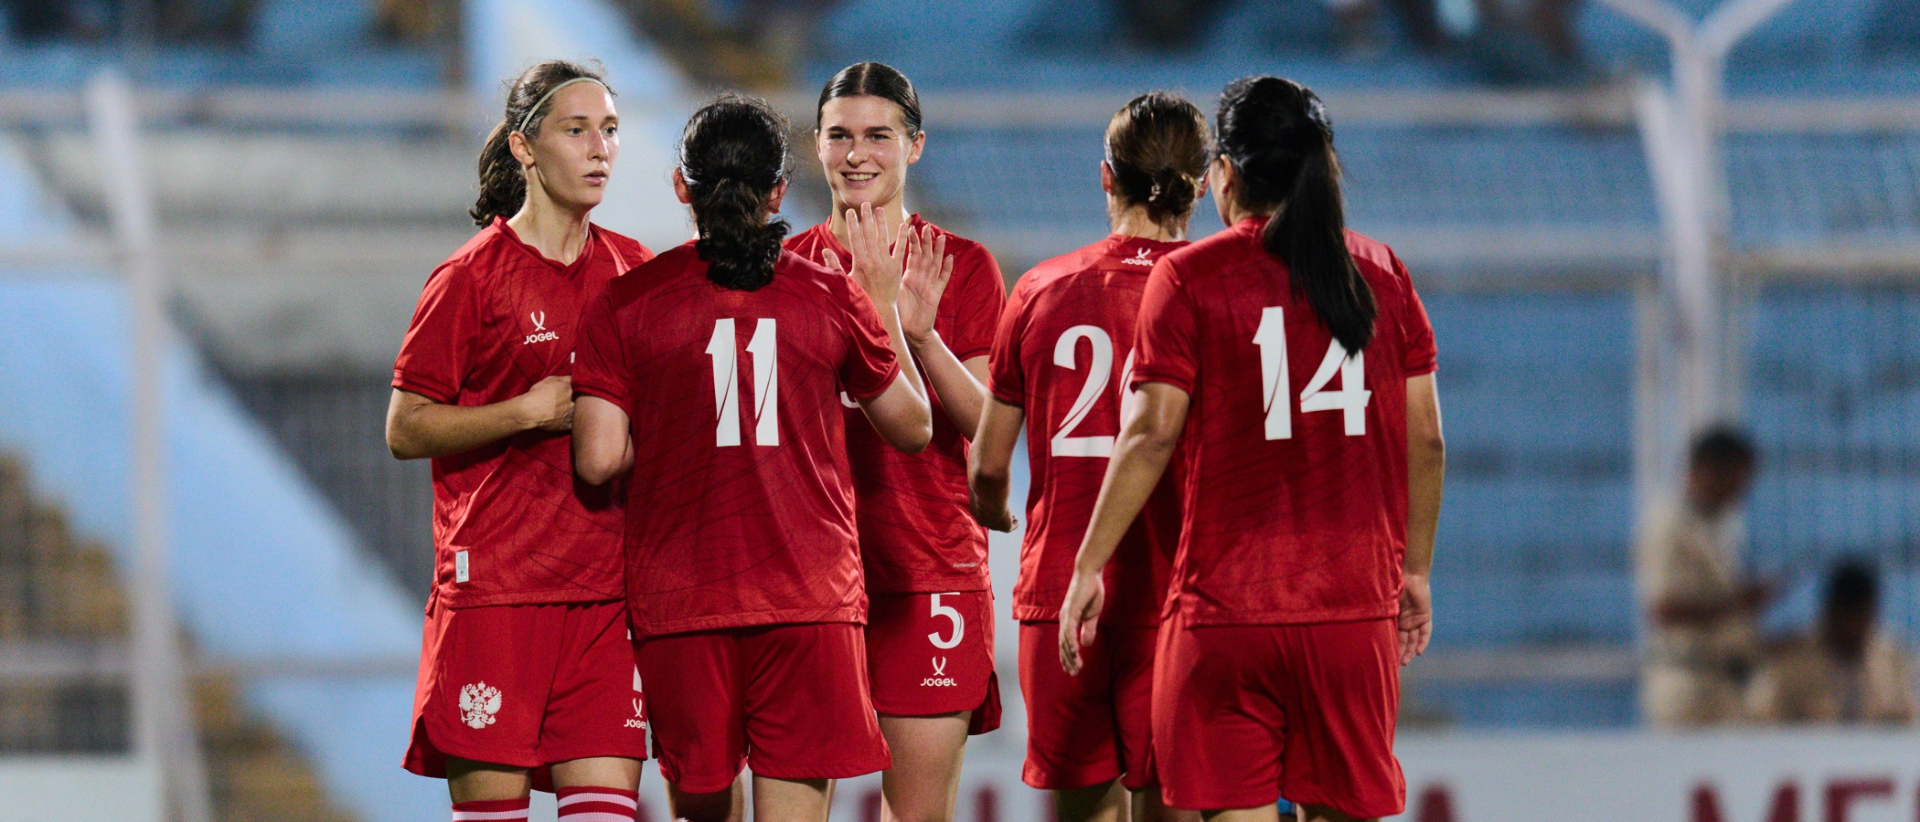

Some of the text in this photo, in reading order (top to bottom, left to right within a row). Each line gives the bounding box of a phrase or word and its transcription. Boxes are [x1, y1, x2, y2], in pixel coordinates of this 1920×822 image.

[705, 318, 779, 447] 11
[1051, 324, 1136, 458] 2
[1252, 306, 1372, 440] 14
[928, 592, 964, 649] 5
